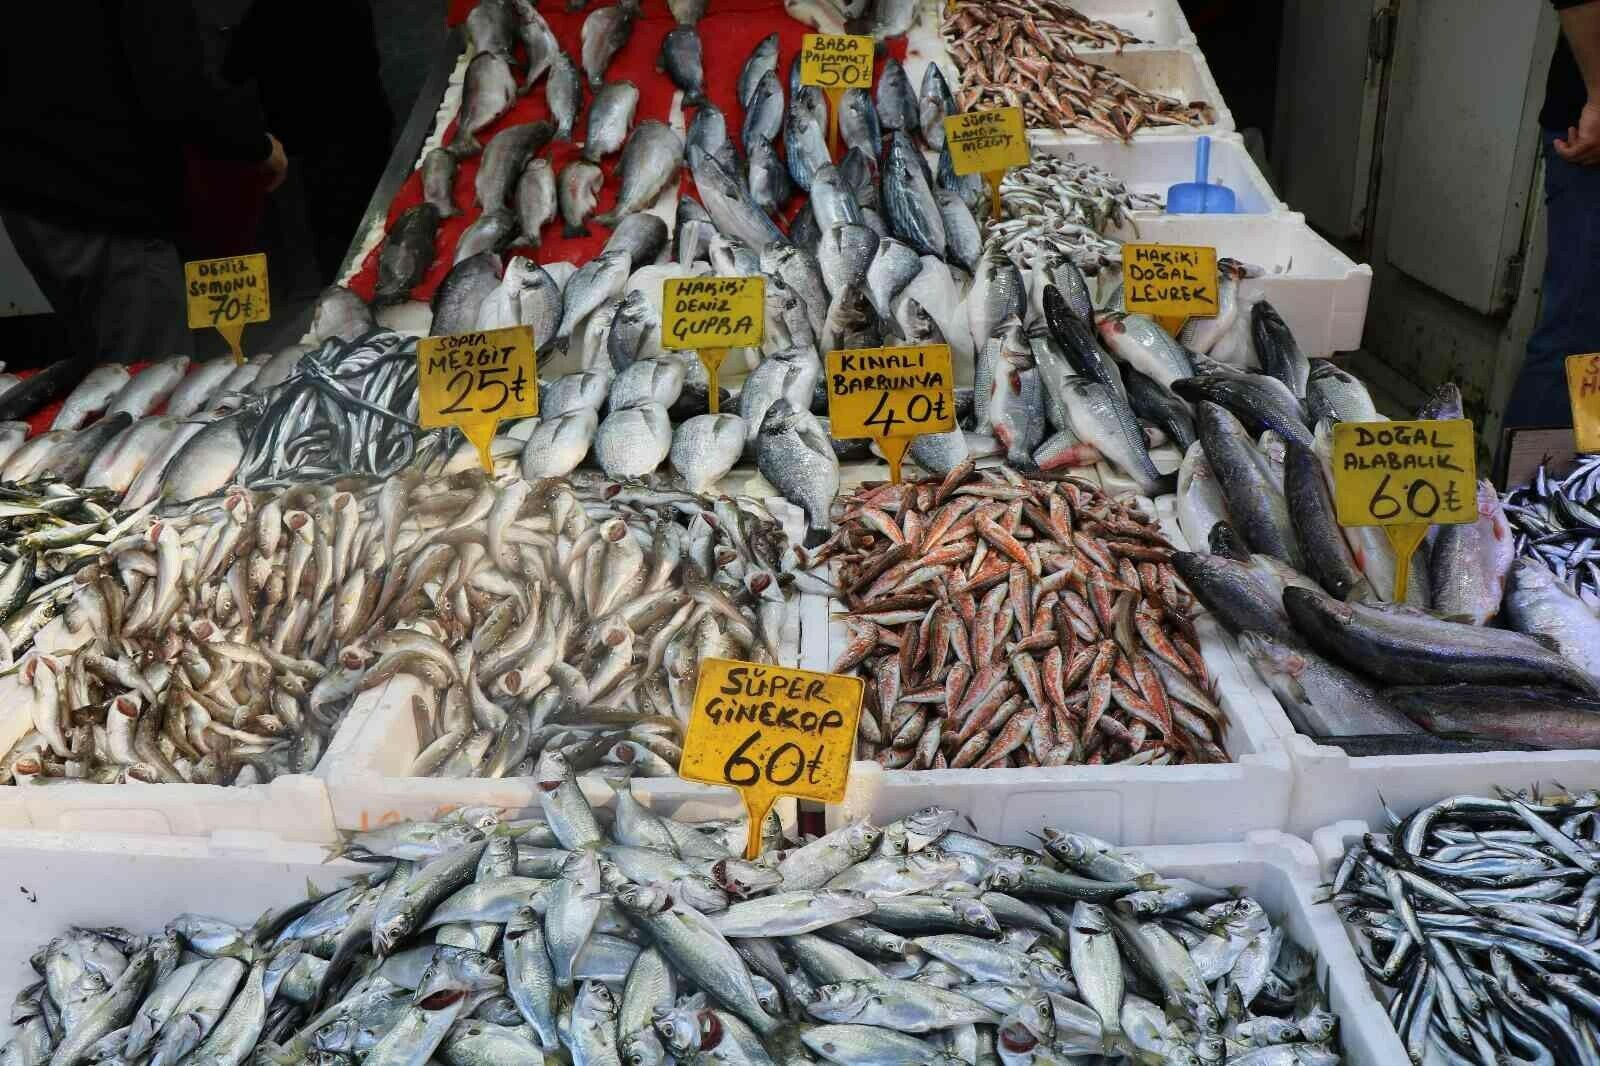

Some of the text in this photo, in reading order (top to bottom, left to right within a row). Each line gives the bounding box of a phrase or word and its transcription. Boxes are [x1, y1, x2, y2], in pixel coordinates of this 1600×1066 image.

[813, 37, 858, 51] BABA
[1129, 262, 1199, 281] DOĞAL
[1131, 284, 1214, 304] LEVREK
[841, 352, 924, 372] KINALI
[1354, 425, 1455, 447] DOĞAL
[1343, 451, 1465, 473] ALABALIK
